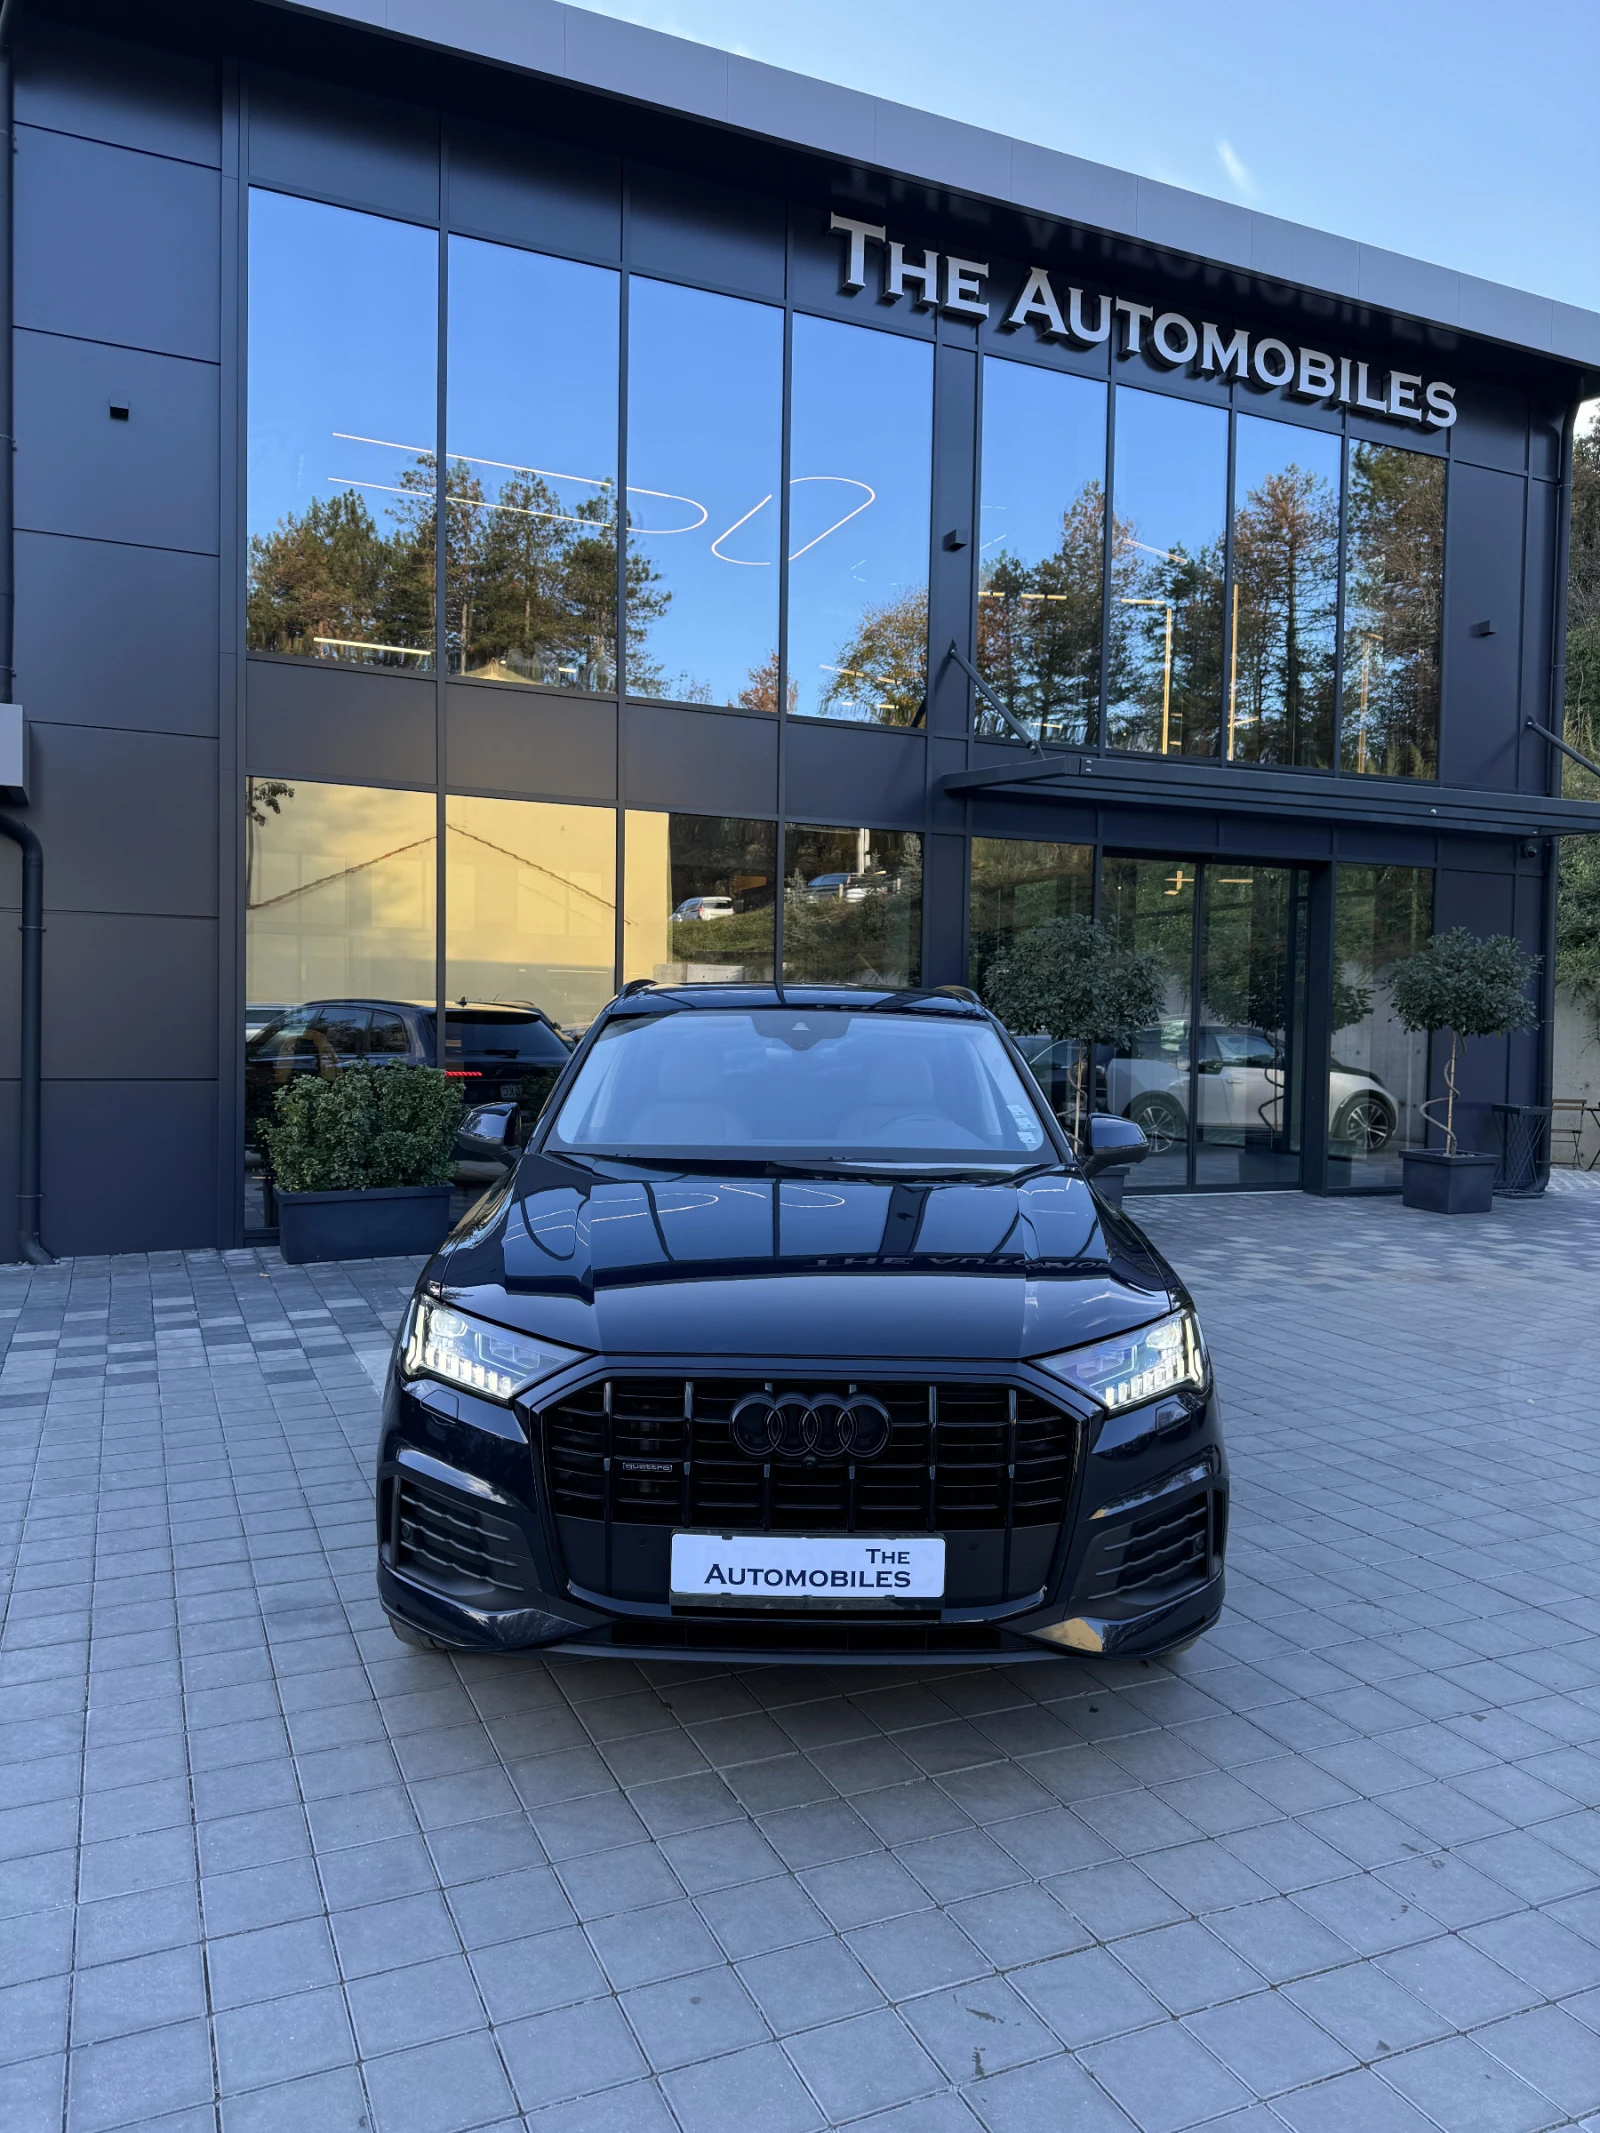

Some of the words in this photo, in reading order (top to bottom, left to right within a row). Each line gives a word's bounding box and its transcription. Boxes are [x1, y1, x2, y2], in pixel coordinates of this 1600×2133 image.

[829, 211, 990, 320] THE
[1004, 266, 1458, 429] AUTOMOBILES
[624, 1463, 671, 1471] quattro
[866, 1548, 910, 1565] THE
[704, 1563, 911, 1588] AUTOMOBILES
